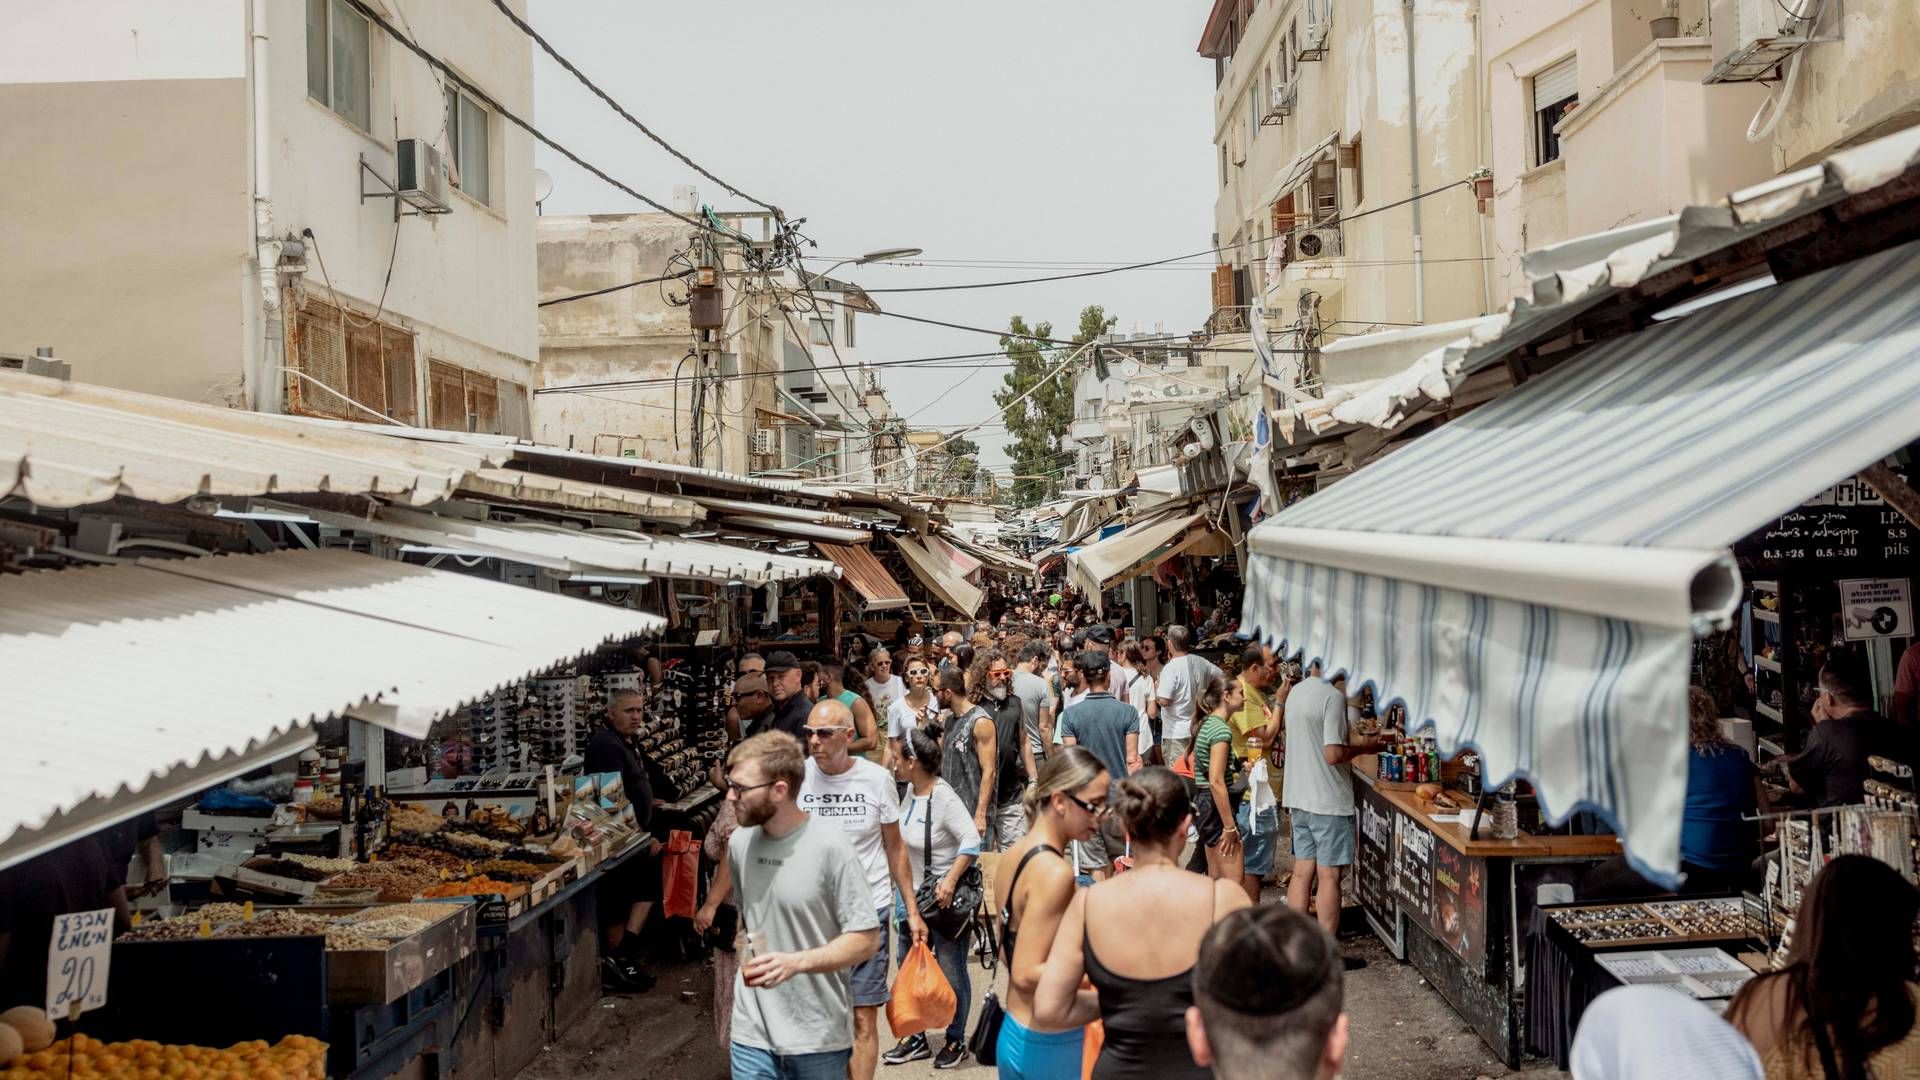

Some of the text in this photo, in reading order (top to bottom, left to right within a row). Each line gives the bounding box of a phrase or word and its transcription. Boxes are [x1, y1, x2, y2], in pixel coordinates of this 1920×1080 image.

[1887, 528, 1908, 539] 8.8
[1884, 542, 1911, 559] pils
[803, 793, 865, 804] G-STAR
[59, 912, 108, 934] מבצע
[56, 955, 95, 1004] 20
